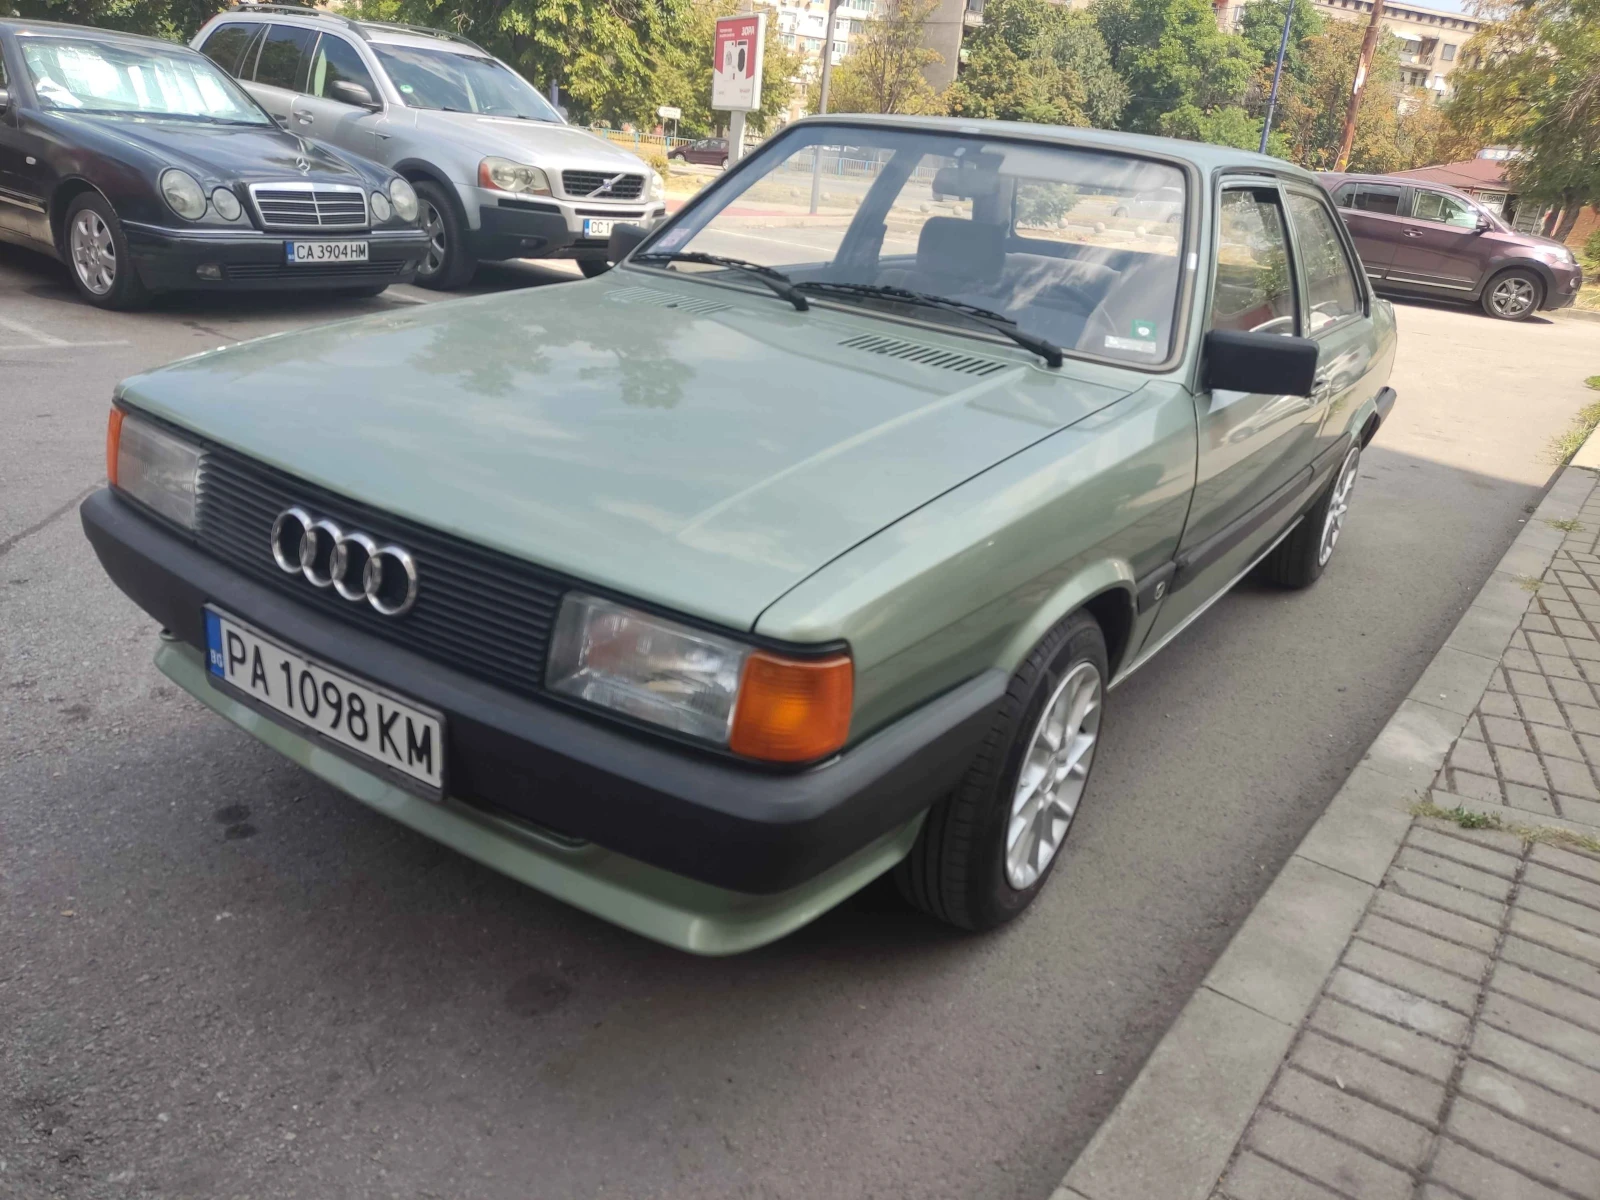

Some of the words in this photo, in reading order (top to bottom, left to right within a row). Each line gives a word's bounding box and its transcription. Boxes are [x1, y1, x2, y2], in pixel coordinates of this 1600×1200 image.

[296, 245, 314, 259] CA
[317, 245, 348, 259] 3904
[350, 244, 366, 257] HM
[210, 649, 224, 668] BG
[226, 629, 270, 696] PA
[279, 660, 369, 742] 1098
[377, 703, 433, 775] KM
